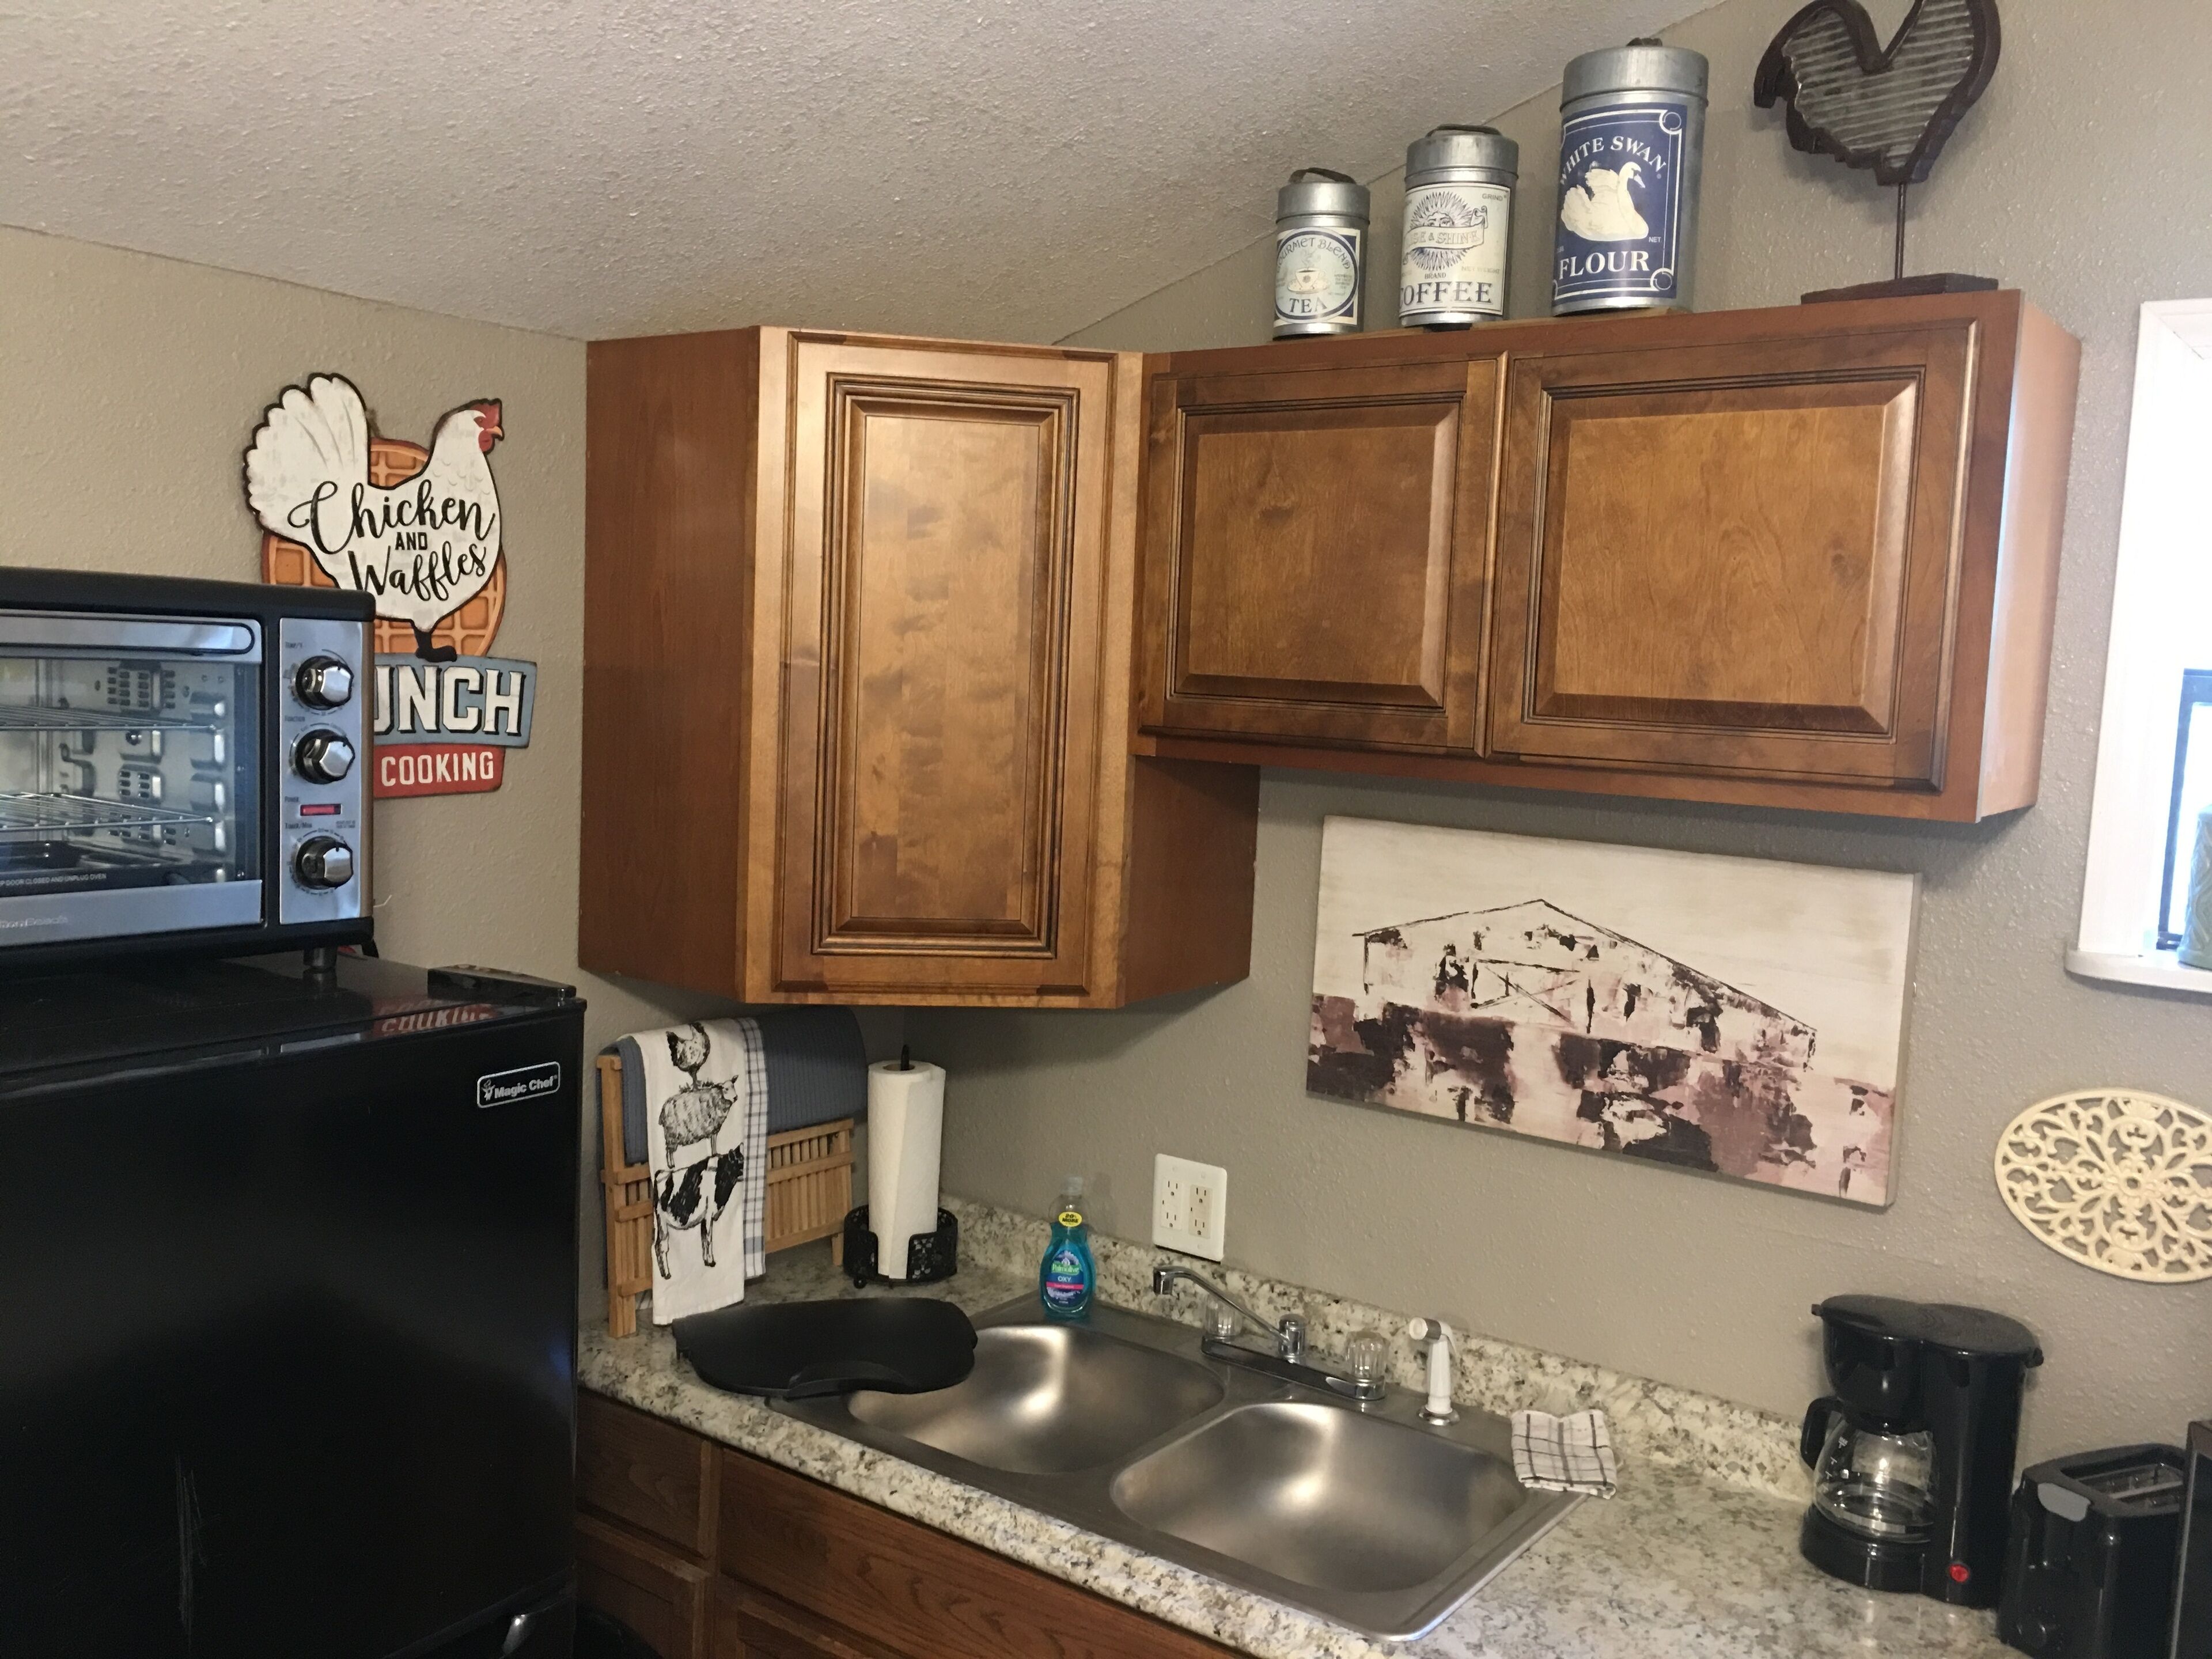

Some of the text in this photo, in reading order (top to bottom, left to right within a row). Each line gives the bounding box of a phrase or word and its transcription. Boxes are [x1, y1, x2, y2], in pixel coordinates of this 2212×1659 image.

[1611, 136, 1666, 172] SWAN
[1482, 194, 1503, 202] GRIND
[1435, 230, 1480, 245] SHINE
[1317, 238, 1351, 269] BLEND
[1559, 251, 1650, 280] FLOUR
[1289, 297, 1327, 313] TEA
[287, 479, 495, 554] Chicken
[395, 532, 428, 550] AND
[347, 540, 487, 601] Waffles
[381, 751, 494, 787] COOKING
[25, 877, 50, 885] CLOSED
[64, 874, 89, 882] UNPLUG
[494, 1075, 554, 1099] Magic Chef
